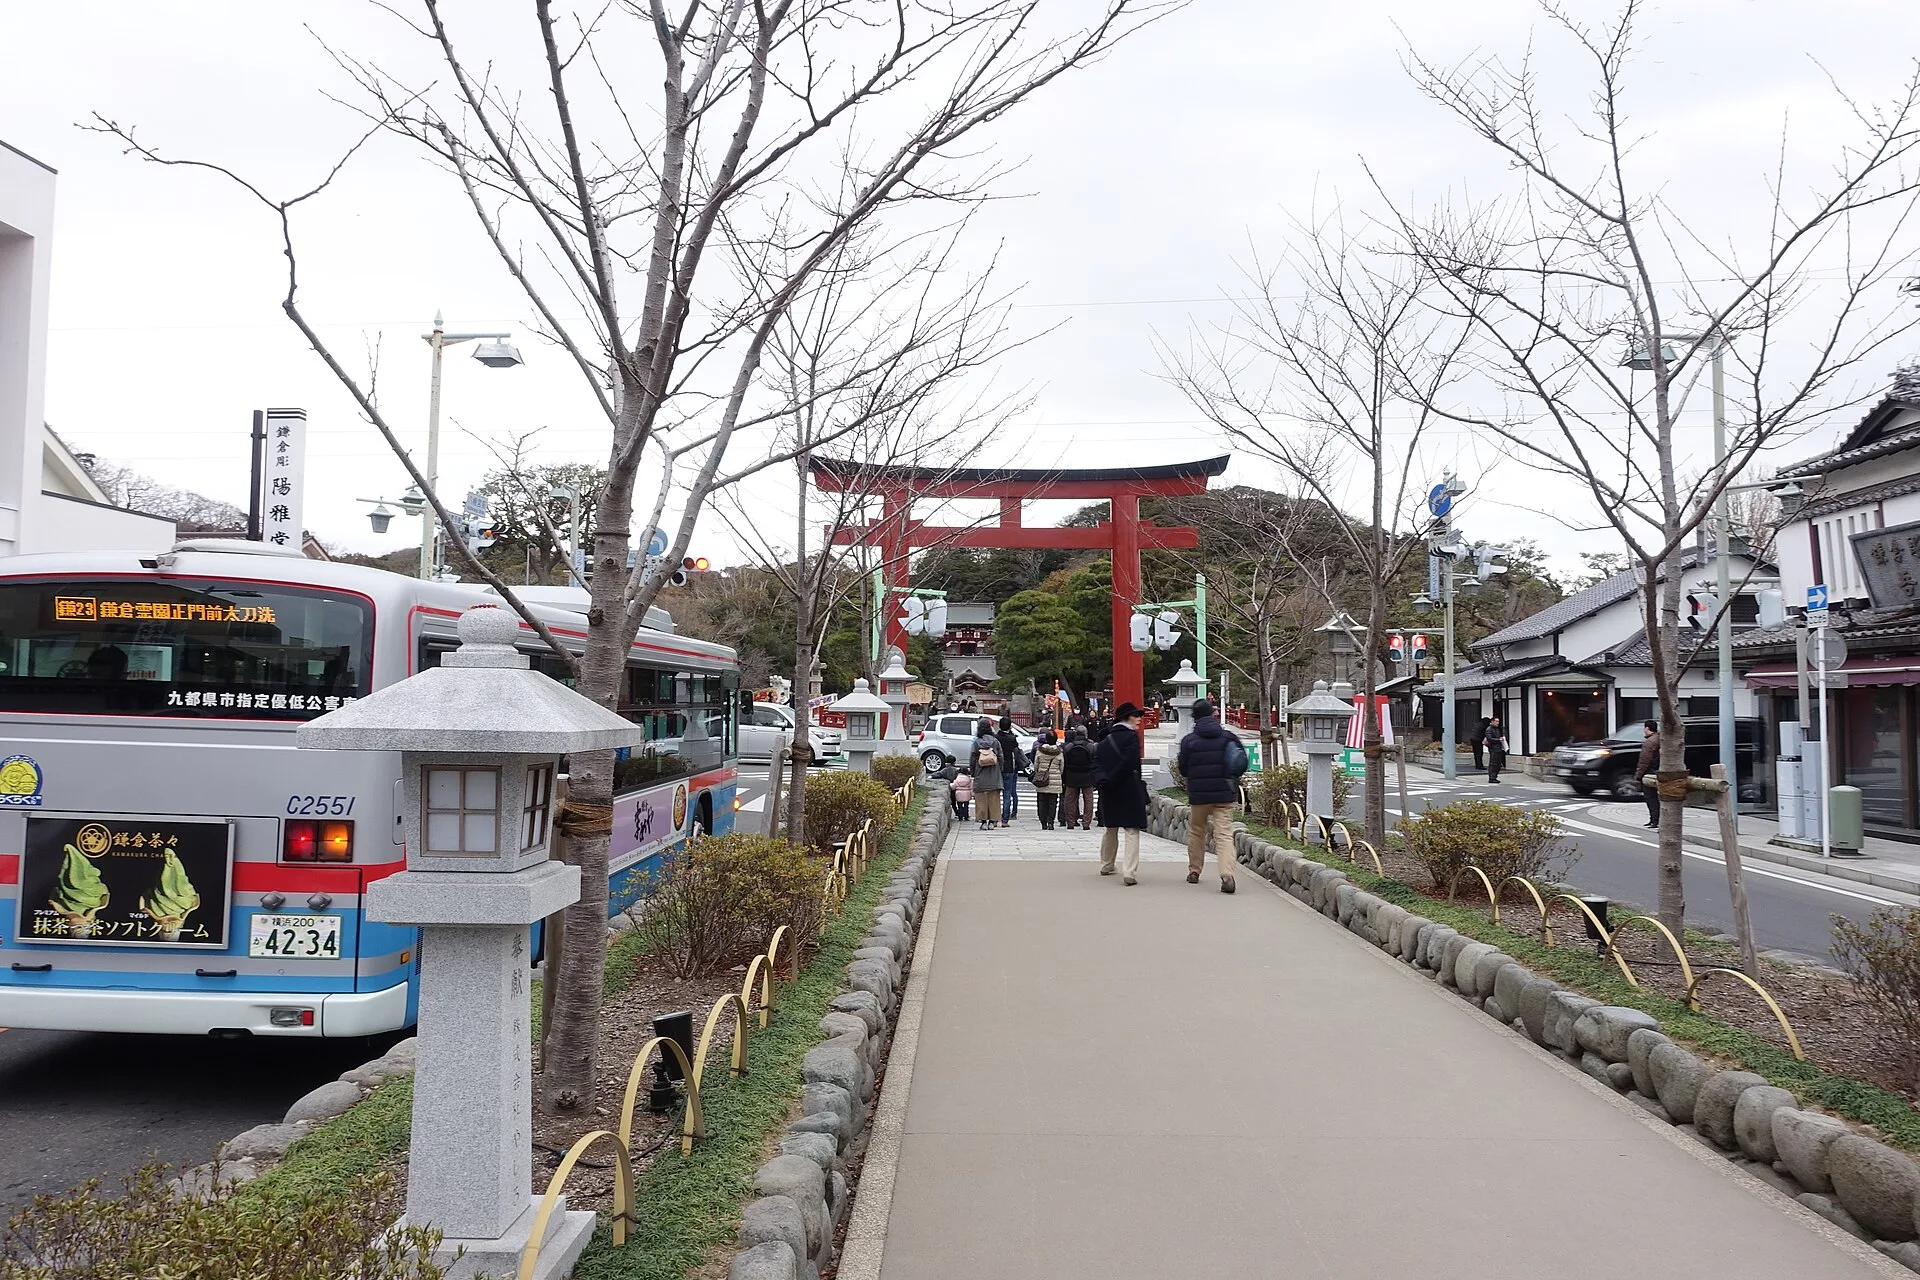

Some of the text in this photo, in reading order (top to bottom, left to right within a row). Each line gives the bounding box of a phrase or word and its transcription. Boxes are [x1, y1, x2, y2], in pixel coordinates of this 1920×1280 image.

[275, 425, 292, 467] 鎌倉彫
[100, 601, 276, 623] 鎌倉霊園正門前太刀洗
[286, 795, 356, 816] C2551
[112, 831, 179, 849] 鎌倉茶々
[272, 918, 315, 927] 横浜 200
[265, 928, 337, 956] 42-34
